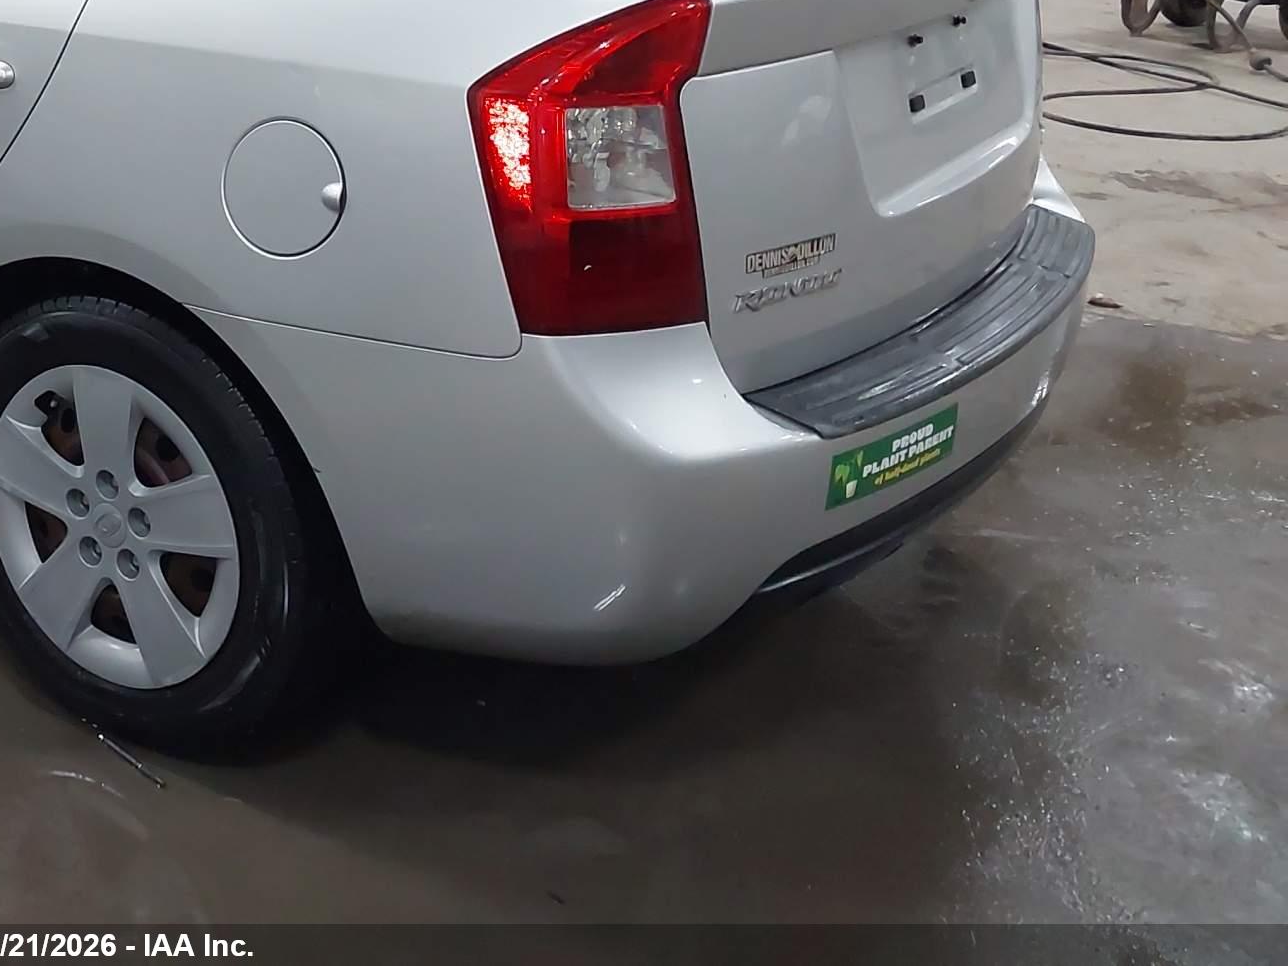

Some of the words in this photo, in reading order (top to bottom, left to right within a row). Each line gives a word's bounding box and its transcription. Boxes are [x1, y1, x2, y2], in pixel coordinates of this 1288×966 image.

[747, 247, 791, 273] DENNIS
[796, 235, 834, 262] DILLON
[862, 452, 907, 478] PLANT
[908, 425, 954, 458] PARENT
[892, 423, 934, 452] PROUD
